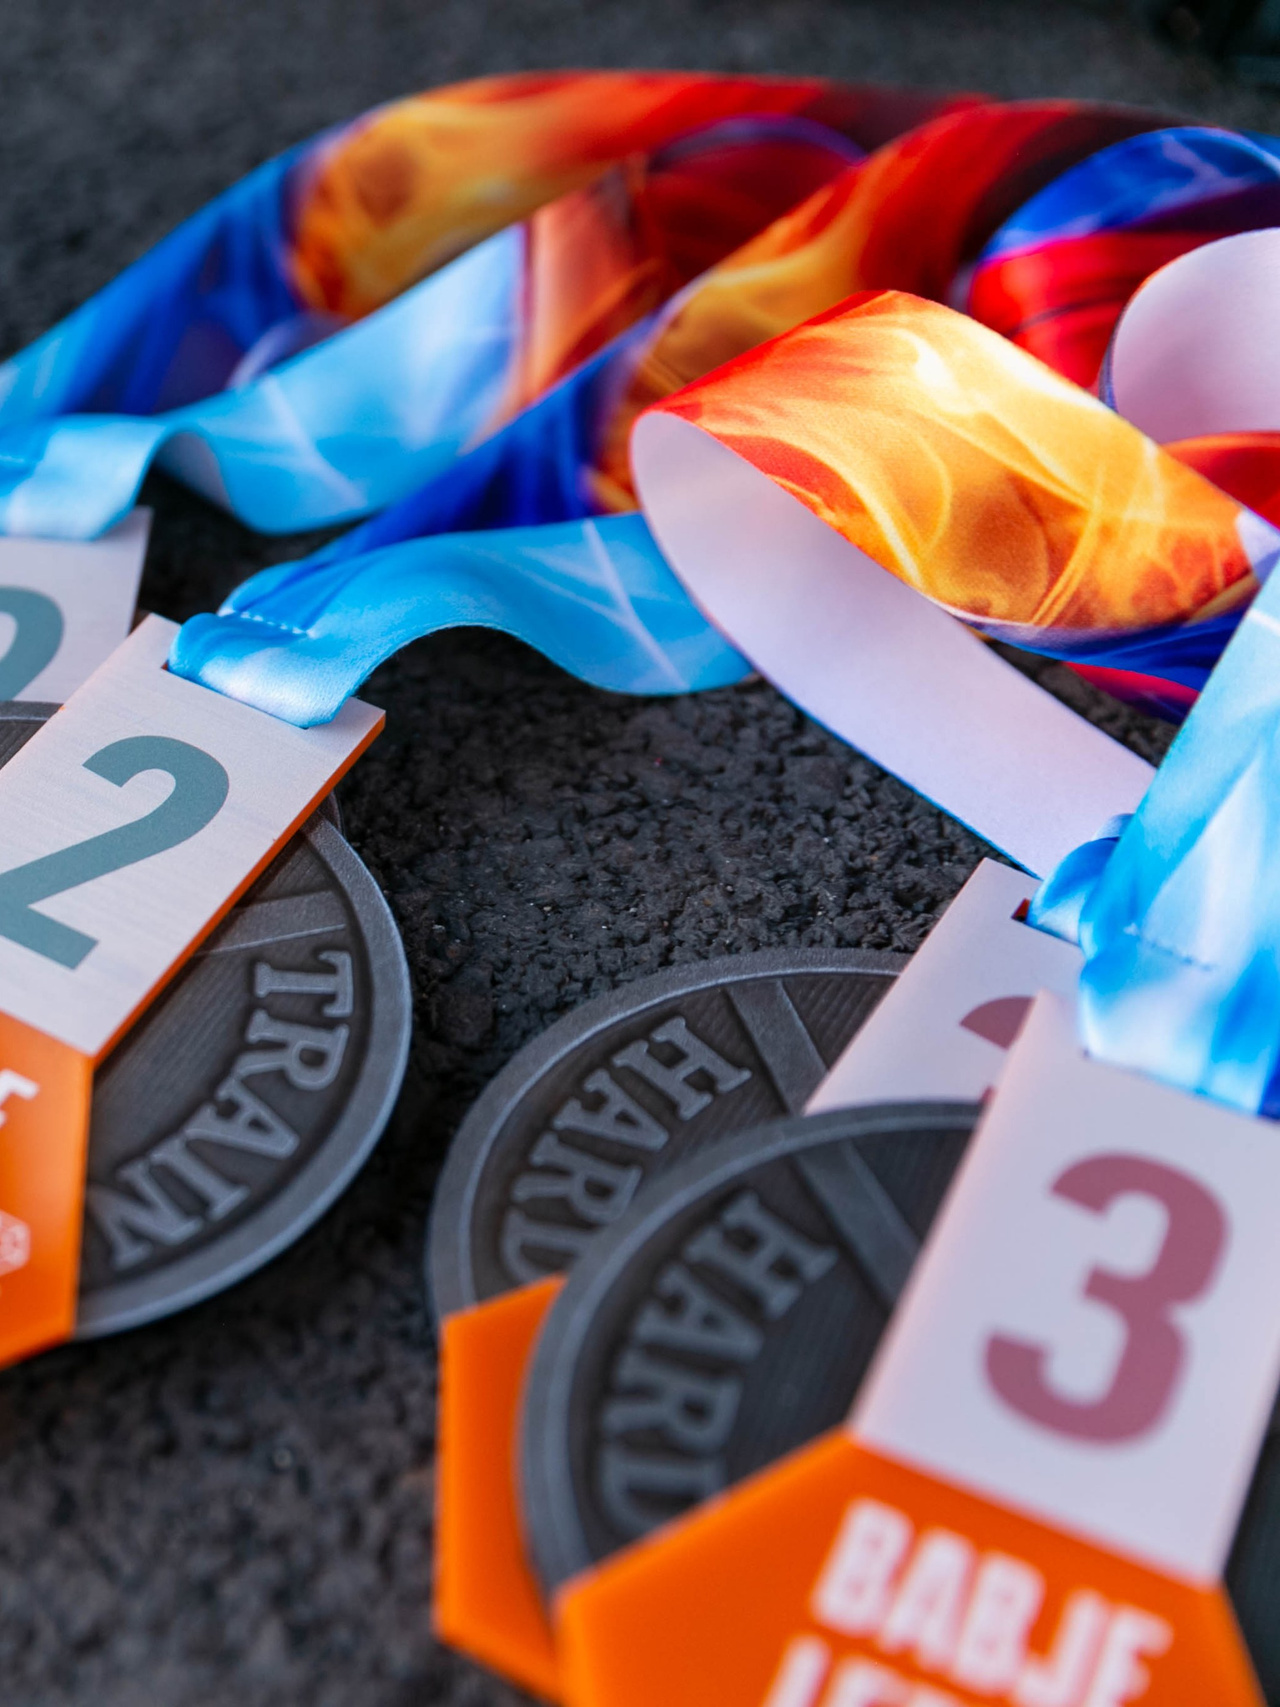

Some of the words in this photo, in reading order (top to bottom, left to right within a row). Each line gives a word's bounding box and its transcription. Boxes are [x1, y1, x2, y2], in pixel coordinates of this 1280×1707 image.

[85, 951, 354, 1269] TRAIN
[500, 1016, 753, 1280] HARD
[602, 1188, 841, 1540] HARD
[982, 1150, 1230, 1450] 3
[810, 1496, 1174, 1707] BABJE
